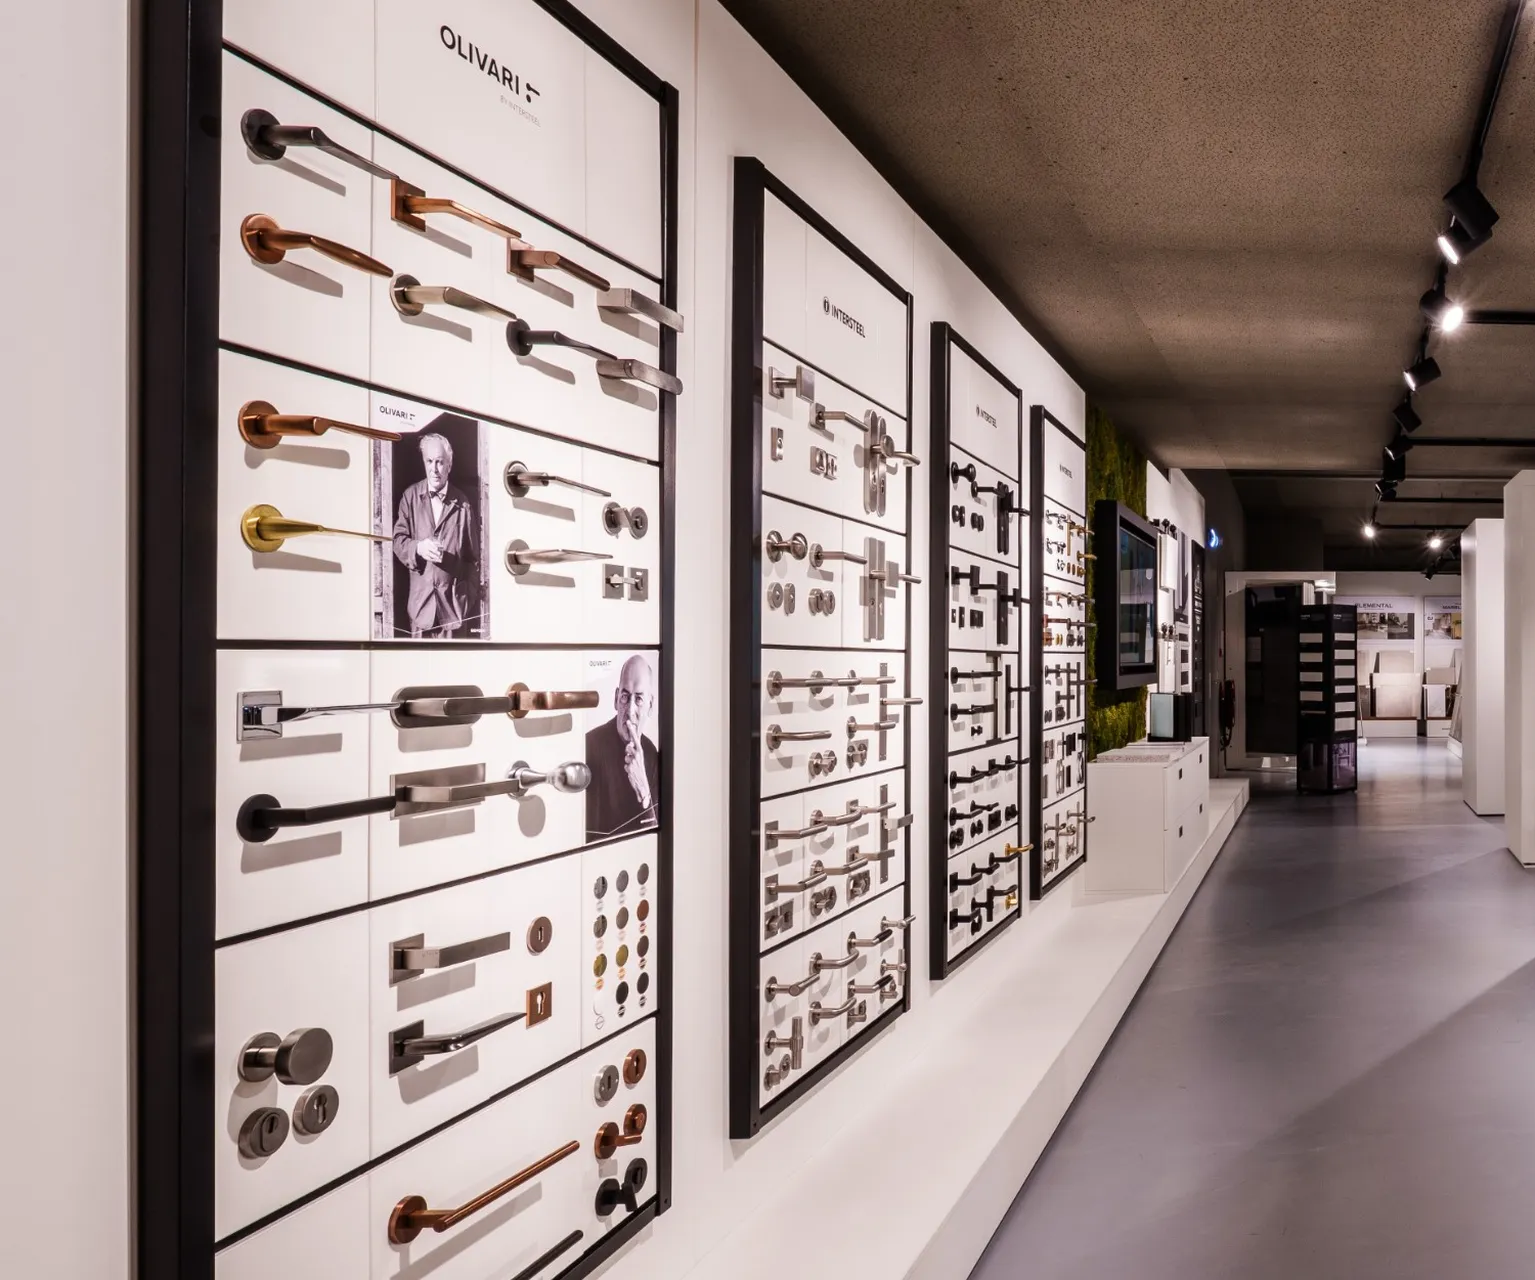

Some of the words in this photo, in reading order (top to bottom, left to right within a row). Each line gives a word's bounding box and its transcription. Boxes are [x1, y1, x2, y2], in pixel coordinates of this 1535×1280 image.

[440, 25, 520, 96] OLIVARI
[831, 304, 866, 338] INTERSTEEL
[379, 405, 409, 420] OLIVARI
